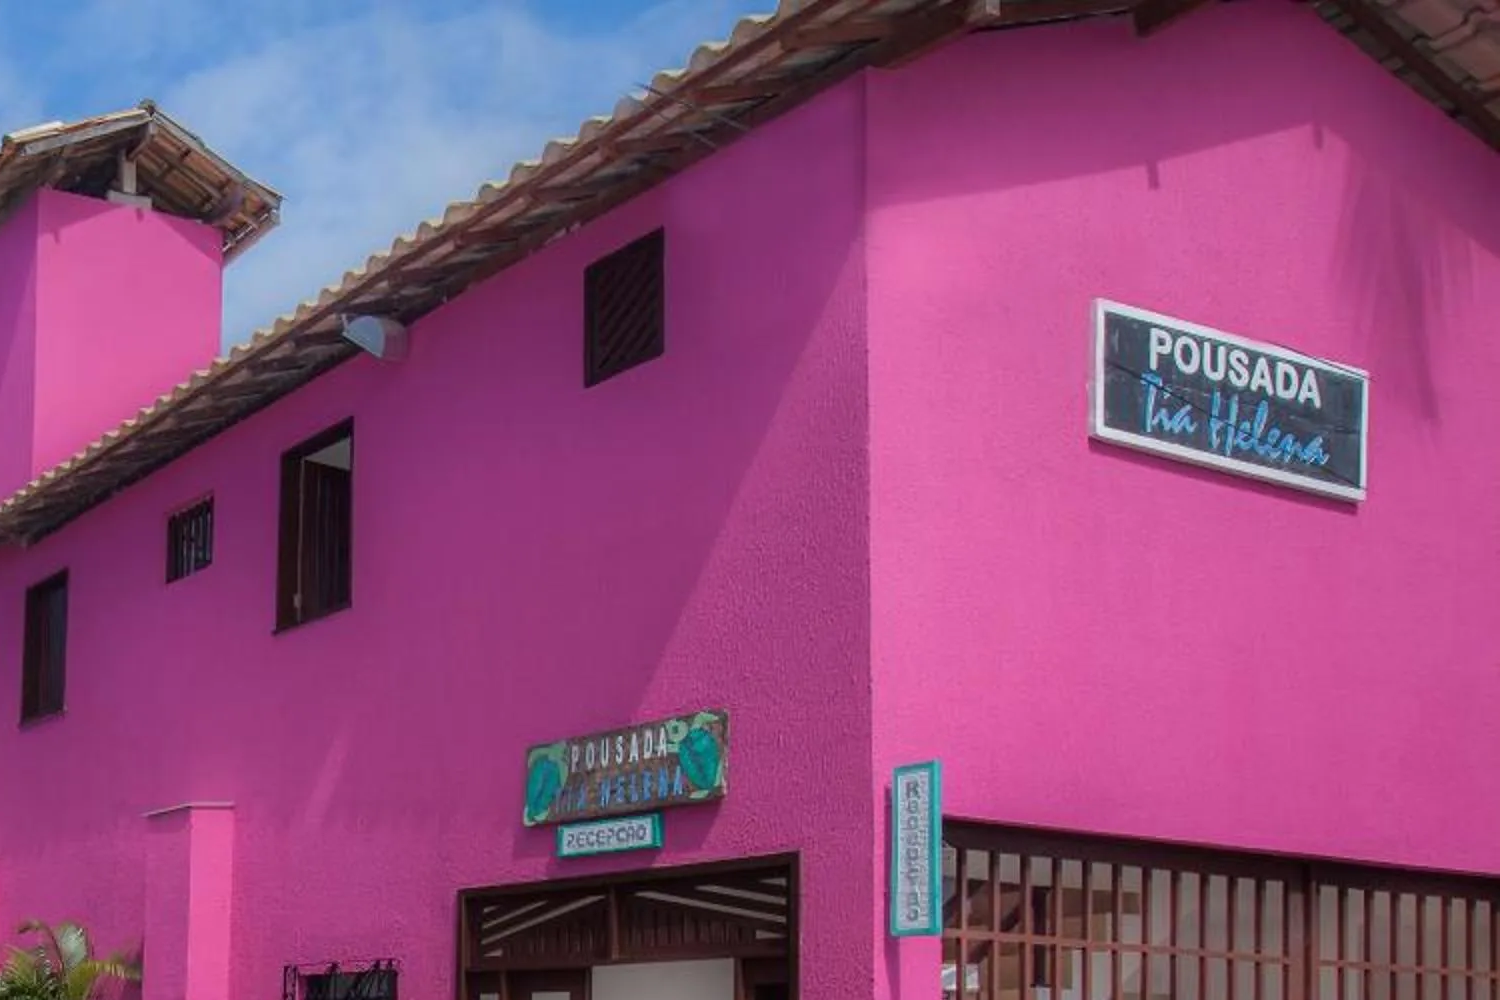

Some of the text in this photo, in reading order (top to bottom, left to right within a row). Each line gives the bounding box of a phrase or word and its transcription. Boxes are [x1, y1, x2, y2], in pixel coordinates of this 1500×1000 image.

[1150, 327, 1322, 409] POUSADA
[1208, 387, 1330, 466] Helena
[571, 726, 668, 773] POUSADA
[600, 764, 684, 809] HELENA
